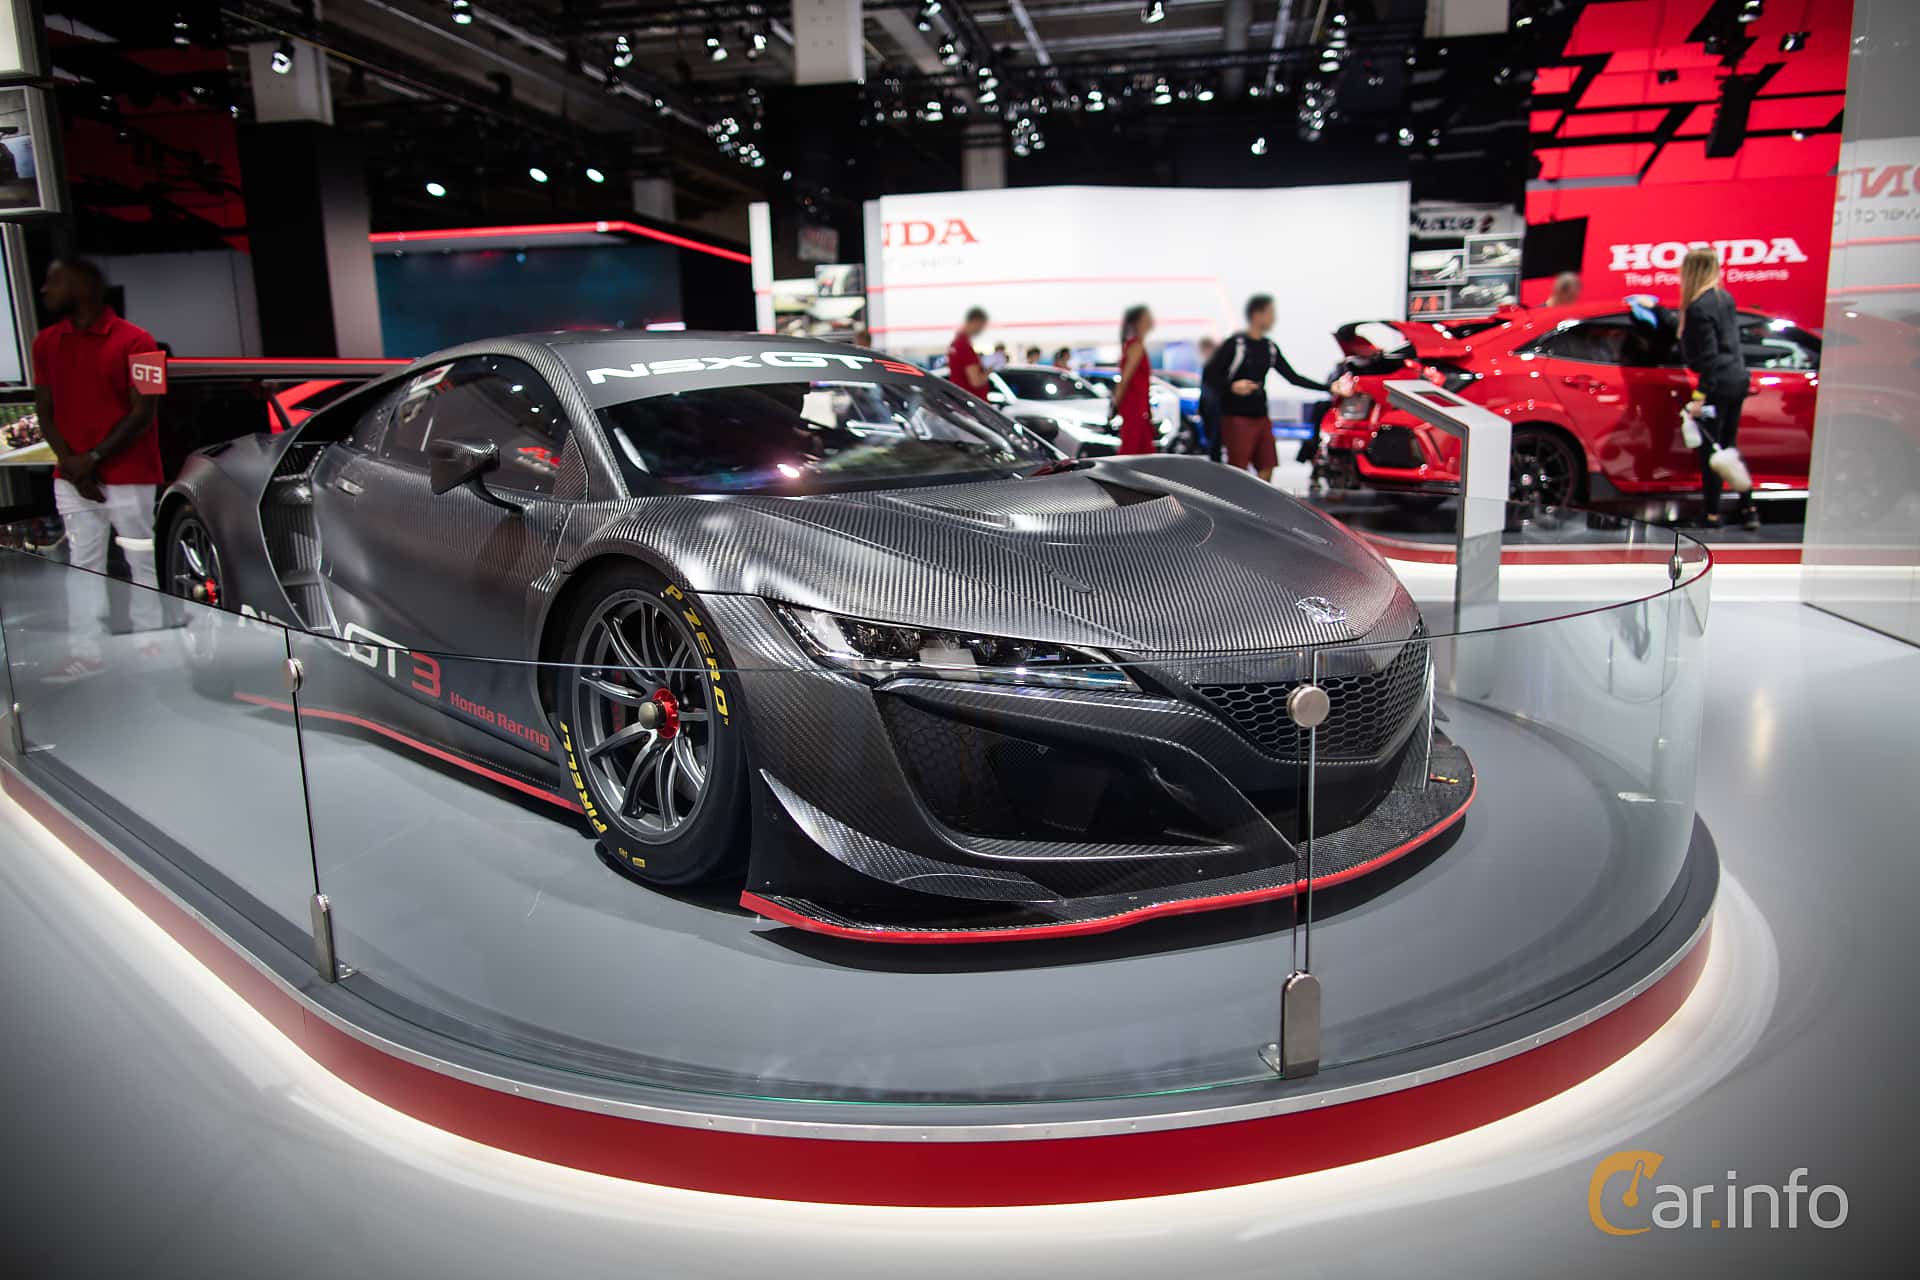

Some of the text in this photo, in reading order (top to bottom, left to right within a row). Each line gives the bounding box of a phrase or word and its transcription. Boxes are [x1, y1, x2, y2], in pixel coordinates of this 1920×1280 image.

[1726, 268, 1789, 283] Dreams
[132, 363, 162, 384] GT3
[344, 622, 441, 698] GT3
[665, 584, 729, 717] P ZERO
[449, 689, 550, 753] Honda Racing
[559, 720, 608, 833] PIRELLI
